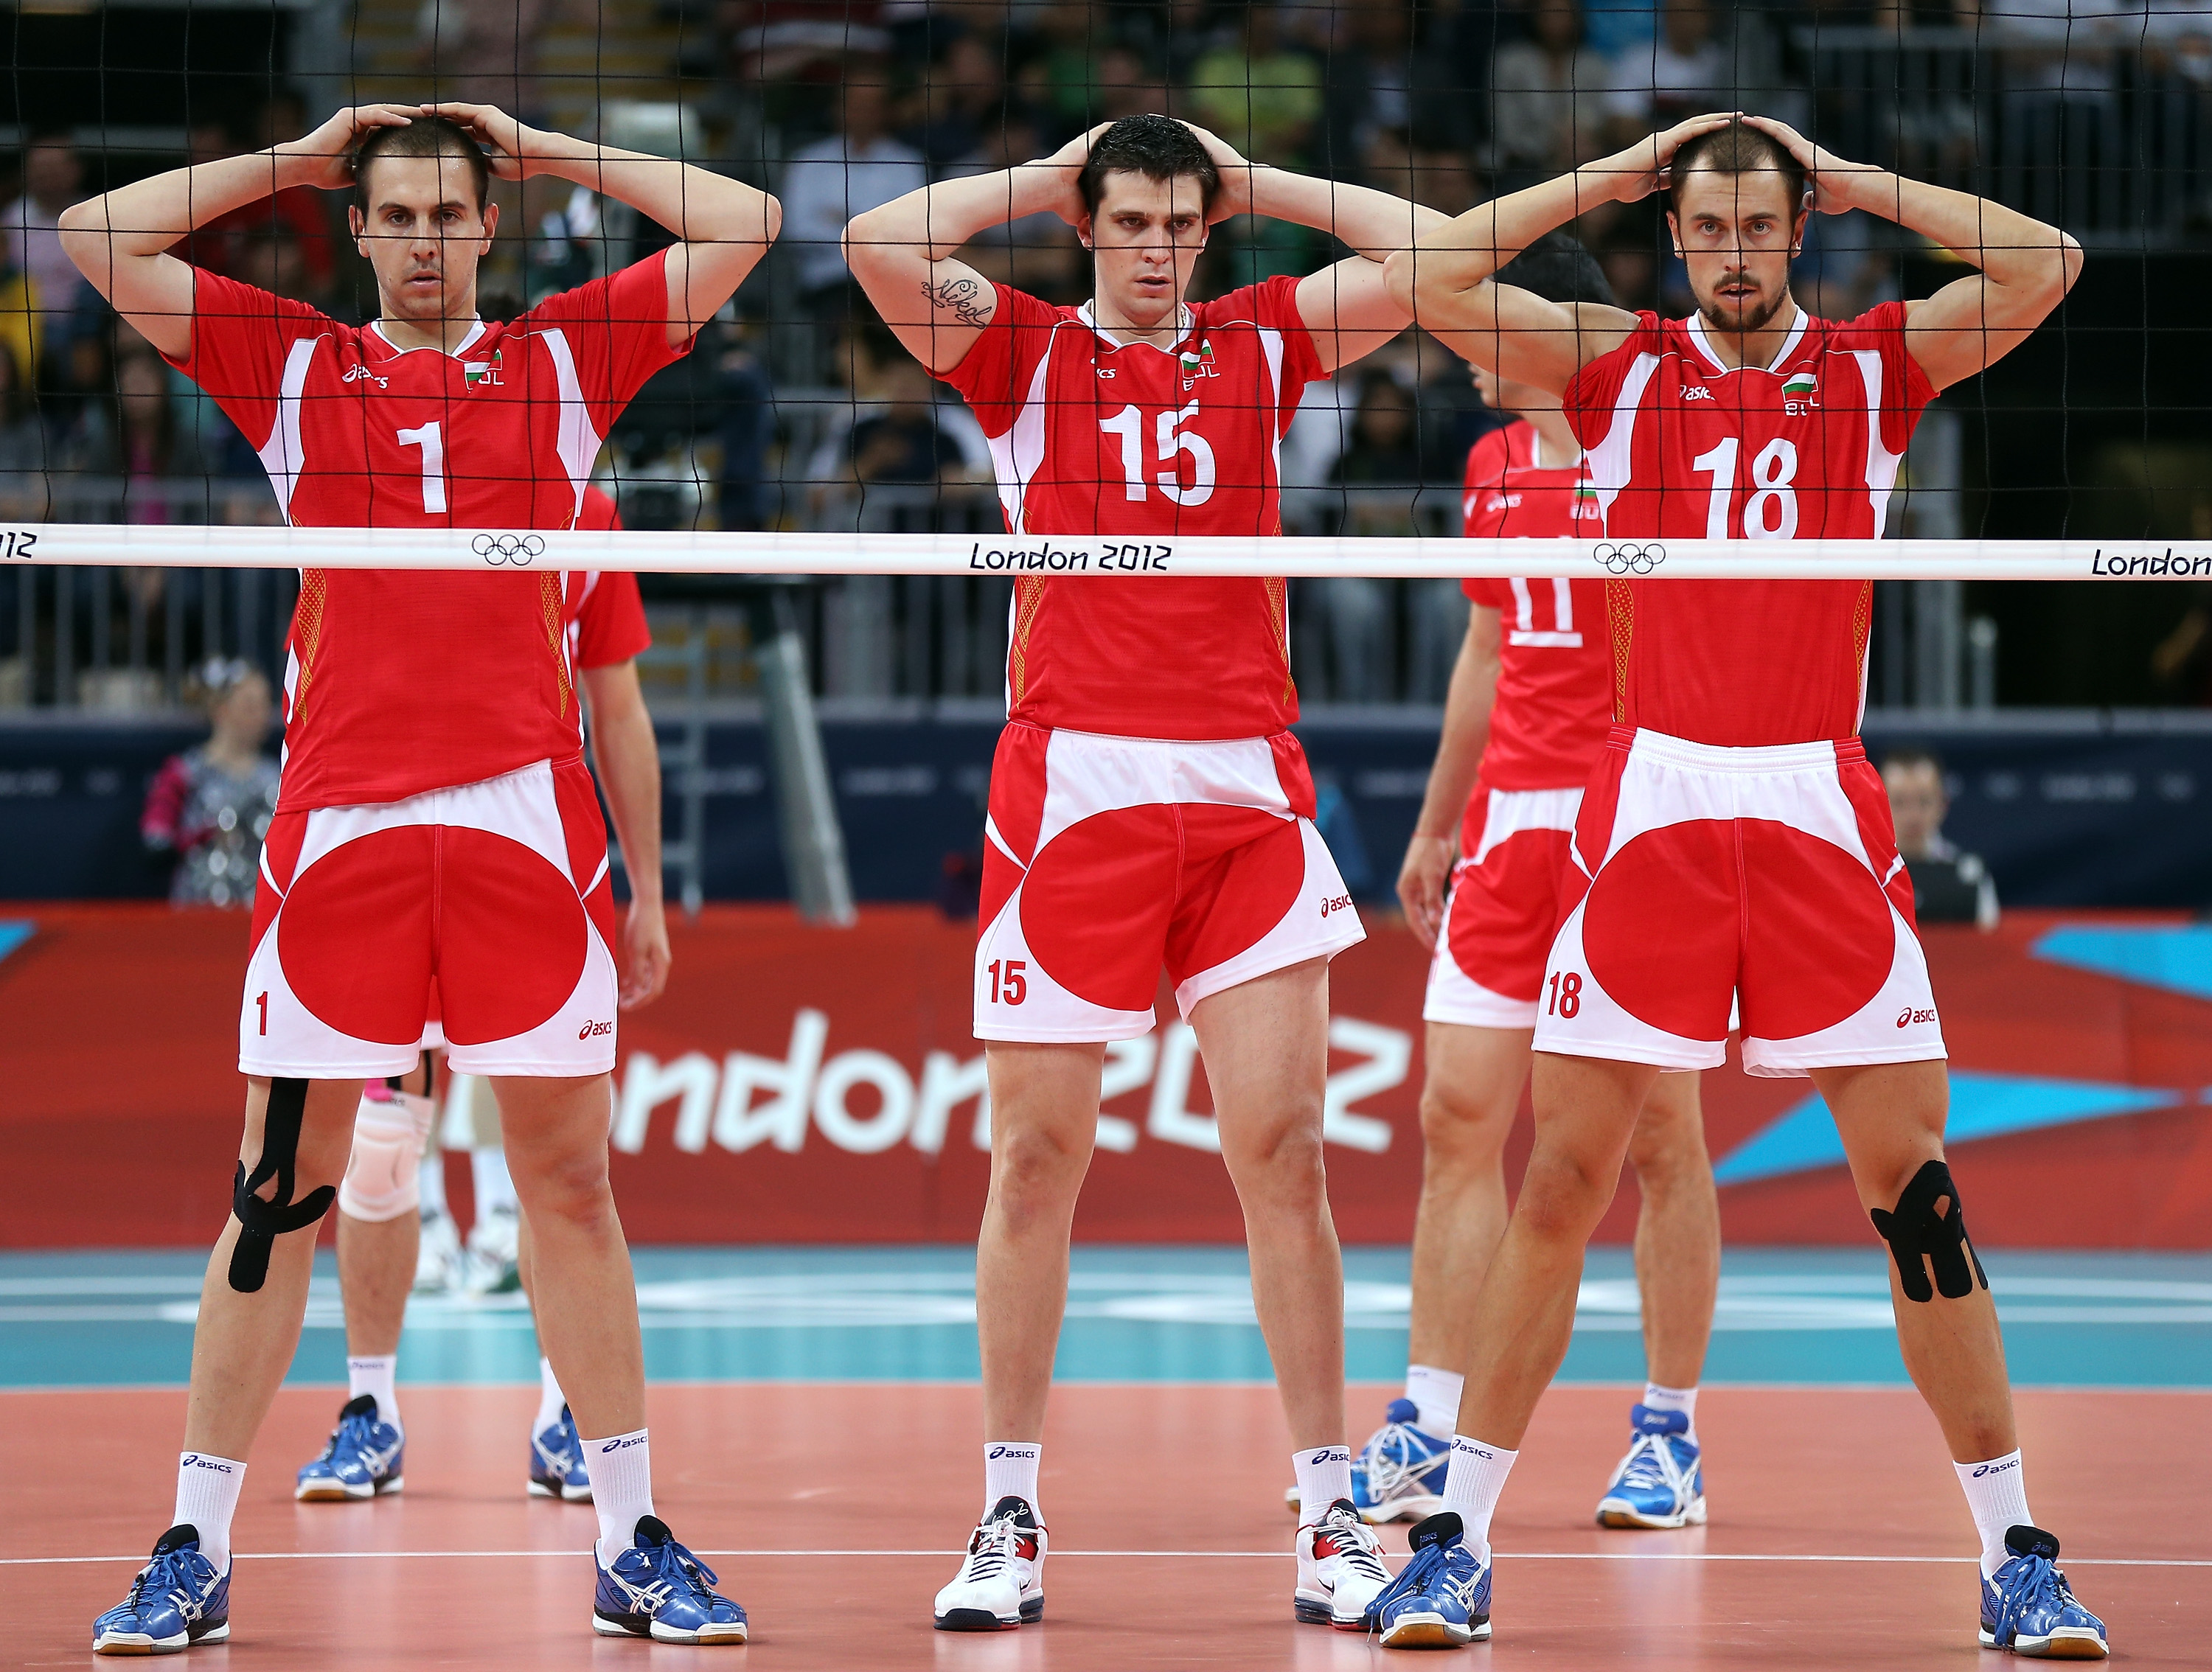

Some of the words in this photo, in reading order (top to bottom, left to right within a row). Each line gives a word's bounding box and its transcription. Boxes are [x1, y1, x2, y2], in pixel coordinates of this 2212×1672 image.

[397, 421, 448, 514] 1
[1099, 399, 1217, 507] 15
[1693, 437, 1798, 539] 18
[970, 543, 1088, 570] London
[1099, 544, 1172, 571] 2012
[2092, 548, 2212, 575] London
[988, 959, 1027, 1006] 15
[1548, 971, 1583, 1020] 18
[256, 991, 268, 1037] 1
[197, 1460, 233, 1474] asics
[1460, 1443, 1494, 1460] asics
